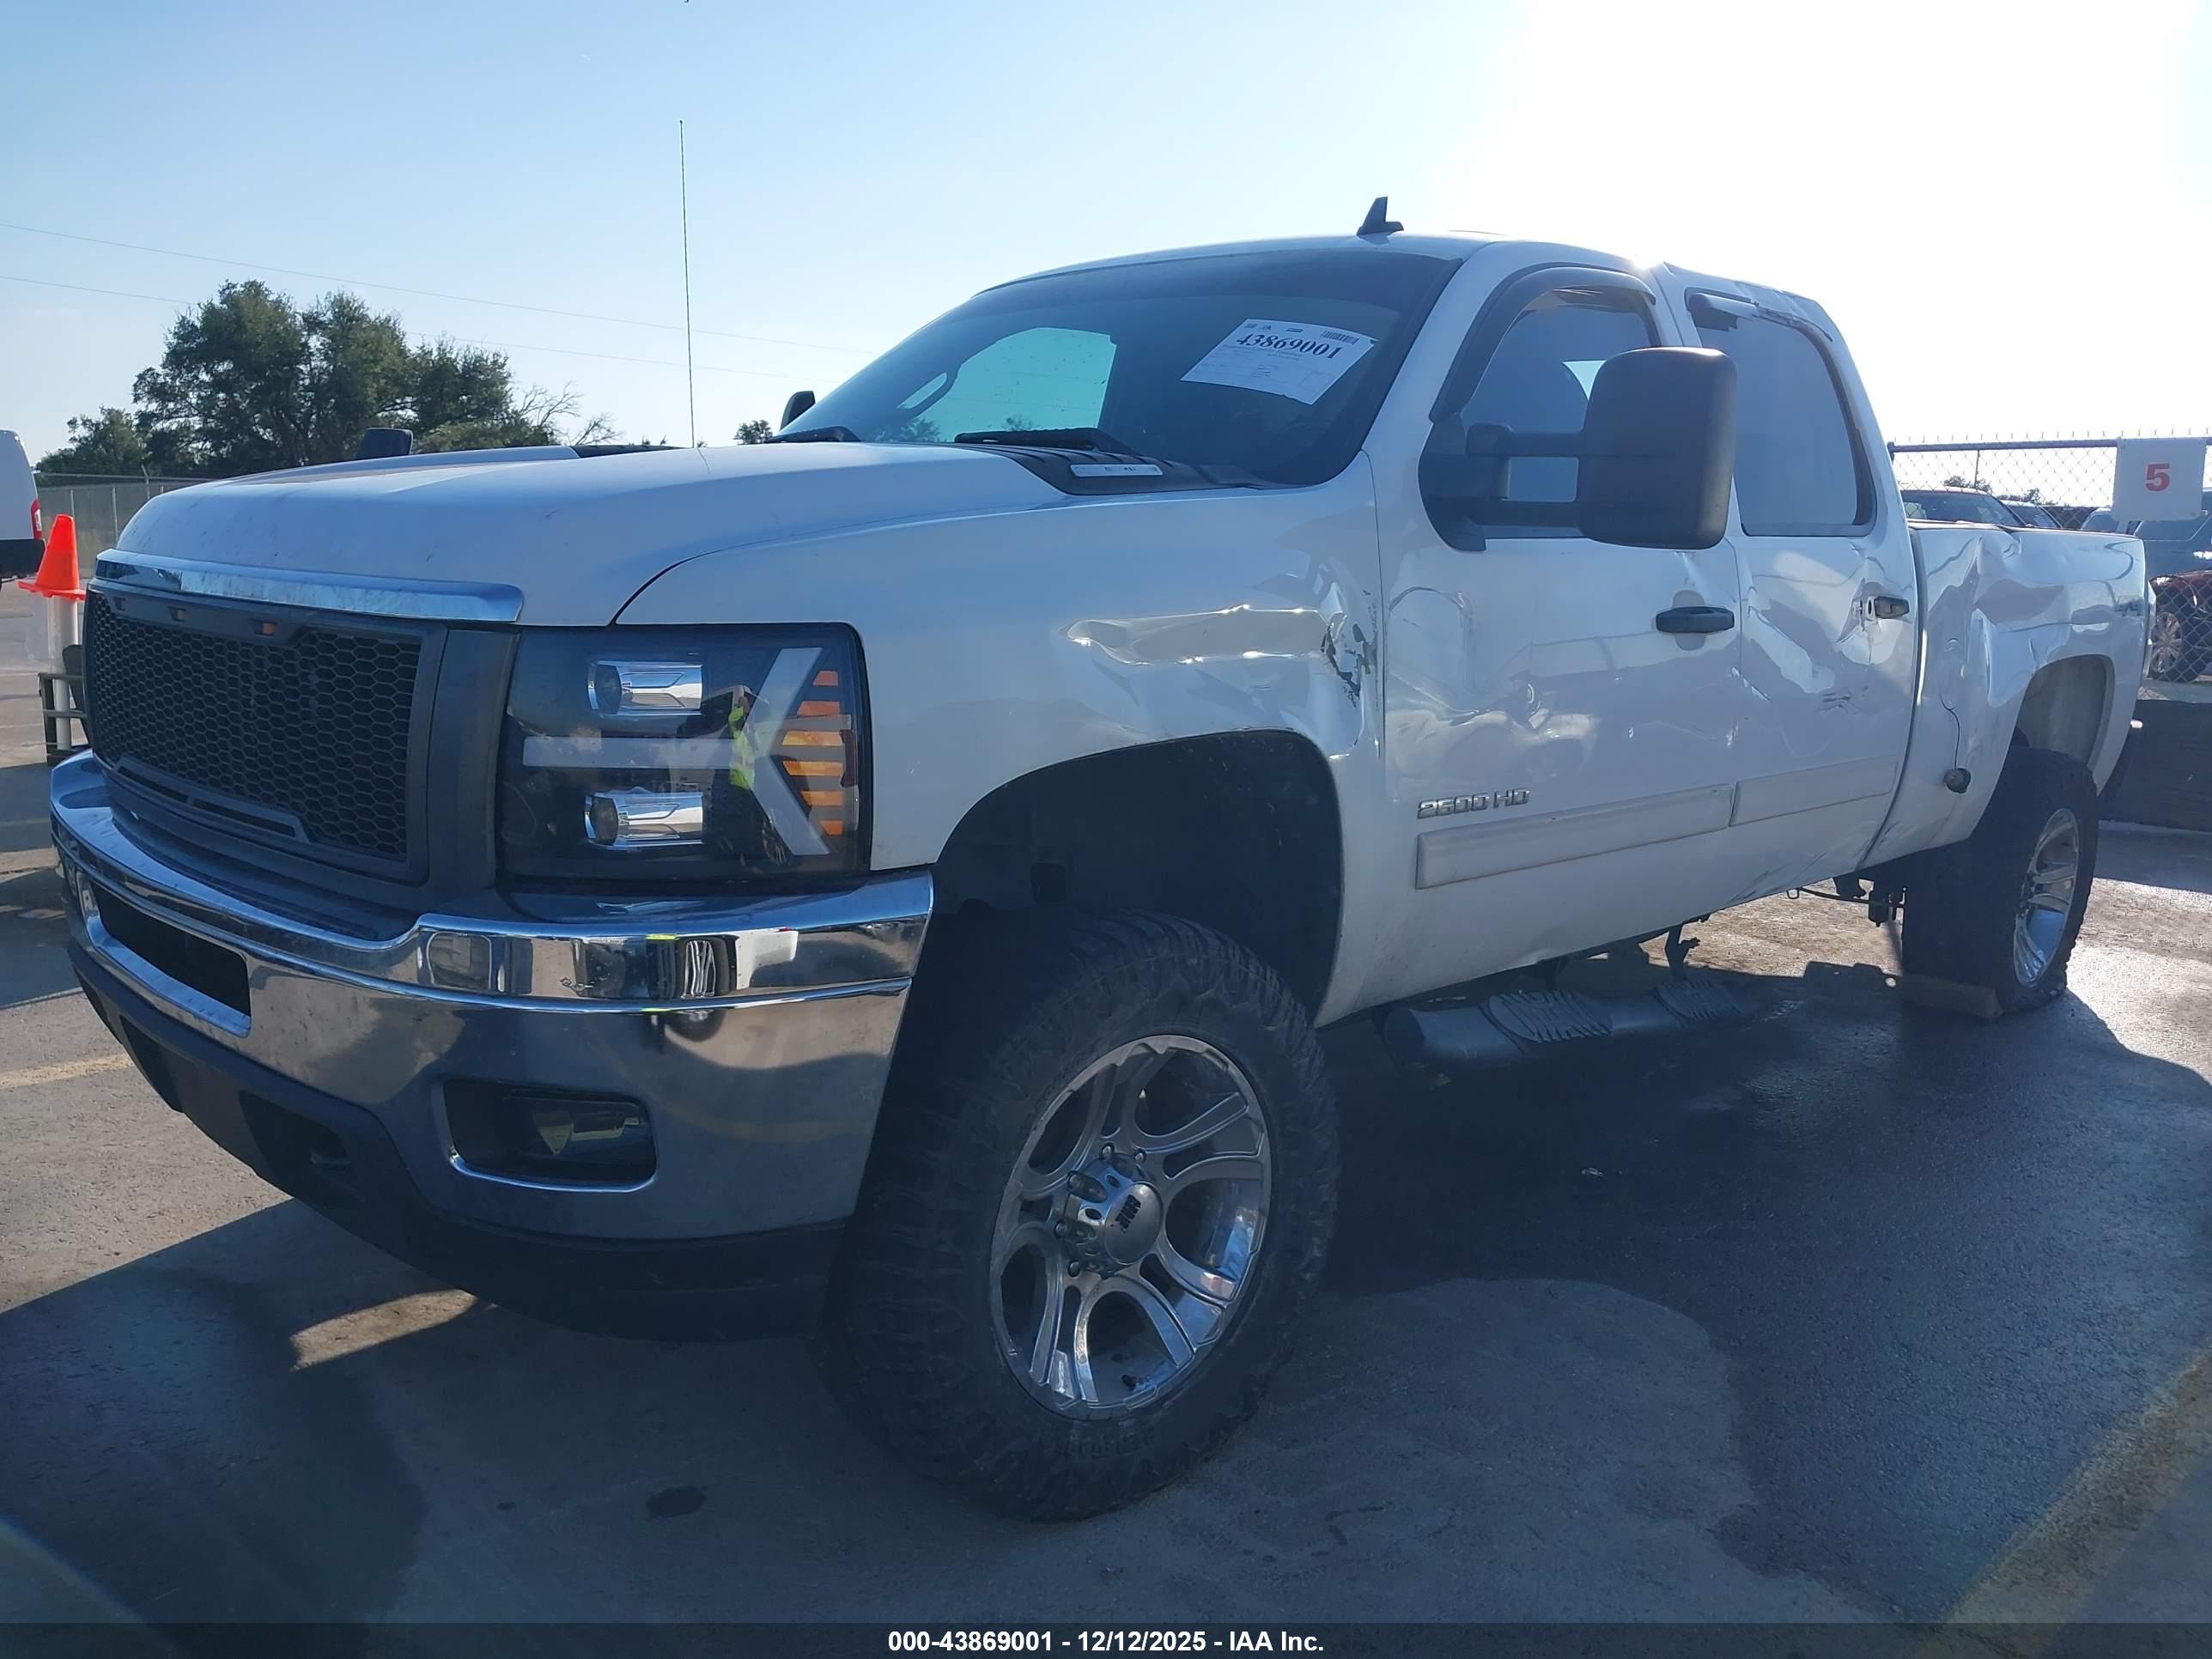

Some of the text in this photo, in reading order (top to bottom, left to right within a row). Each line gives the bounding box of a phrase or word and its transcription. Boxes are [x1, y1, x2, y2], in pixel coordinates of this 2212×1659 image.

[1236, 333, 1343, 358] 43869001
[2145, 464, 2171, 491] 5
[1417, 787, 1530, 819] 2500 HD
